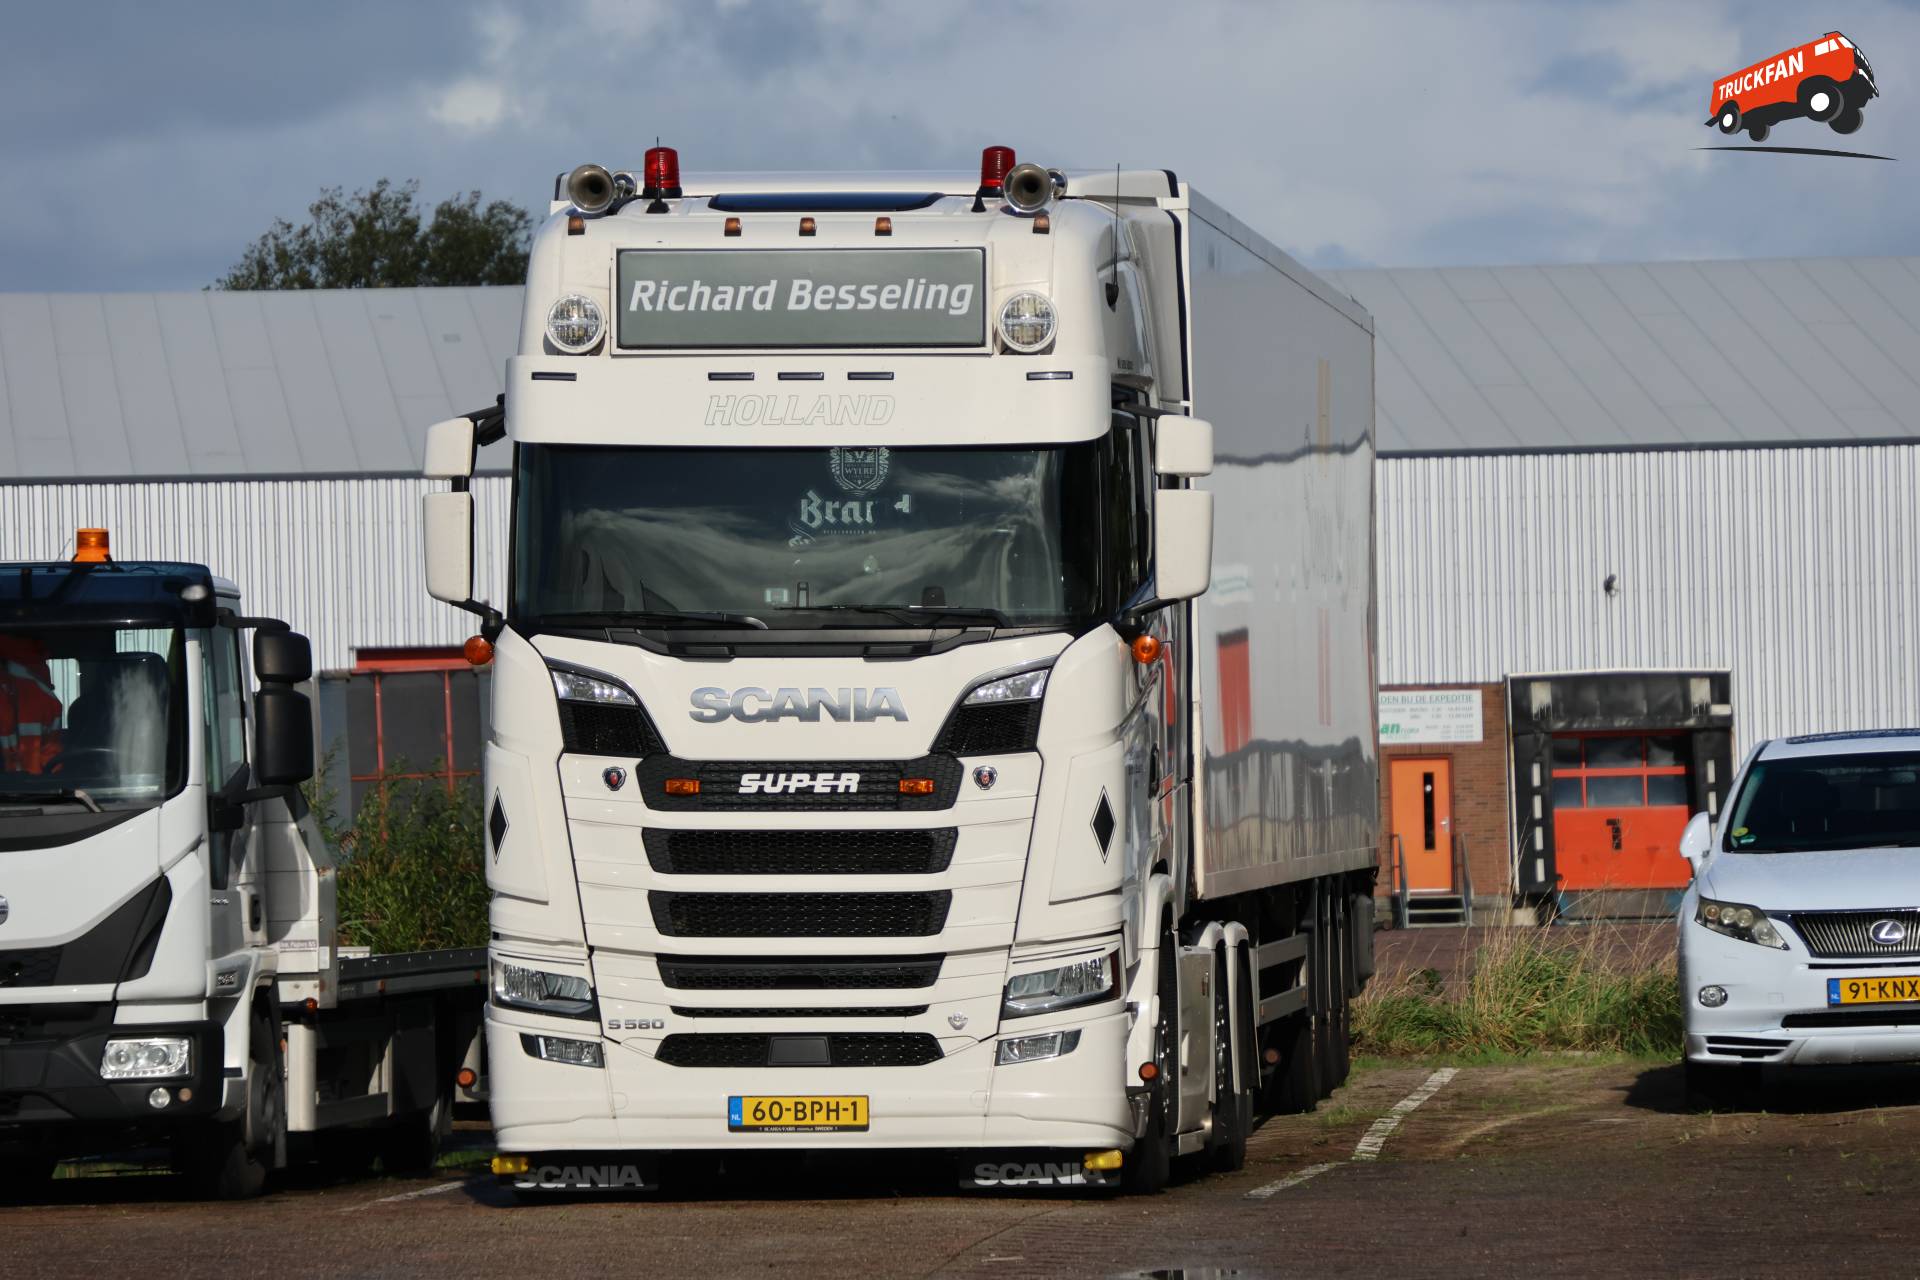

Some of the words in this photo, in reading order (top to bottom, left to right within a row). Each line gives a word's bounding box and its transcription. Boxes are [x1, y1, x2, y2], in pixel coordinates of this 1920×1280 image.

[629, 279, 778, 312] Richard
[787, 278, 974, 315] Besseling
[704, 394, 896, 426] HOLLAND
[689, 687, 909, 723] SCANIA
[1379, 723, 1400, 735] an
[738, 773, 861, 794] SUPER
[731, 1113, 741, 1121] NL
[752, 1101, 858, 1121] 60-BPH-1
[513, 1165, 646, 1189] SCANIA
[974, 1162, 1107, 1186] SCANIA
